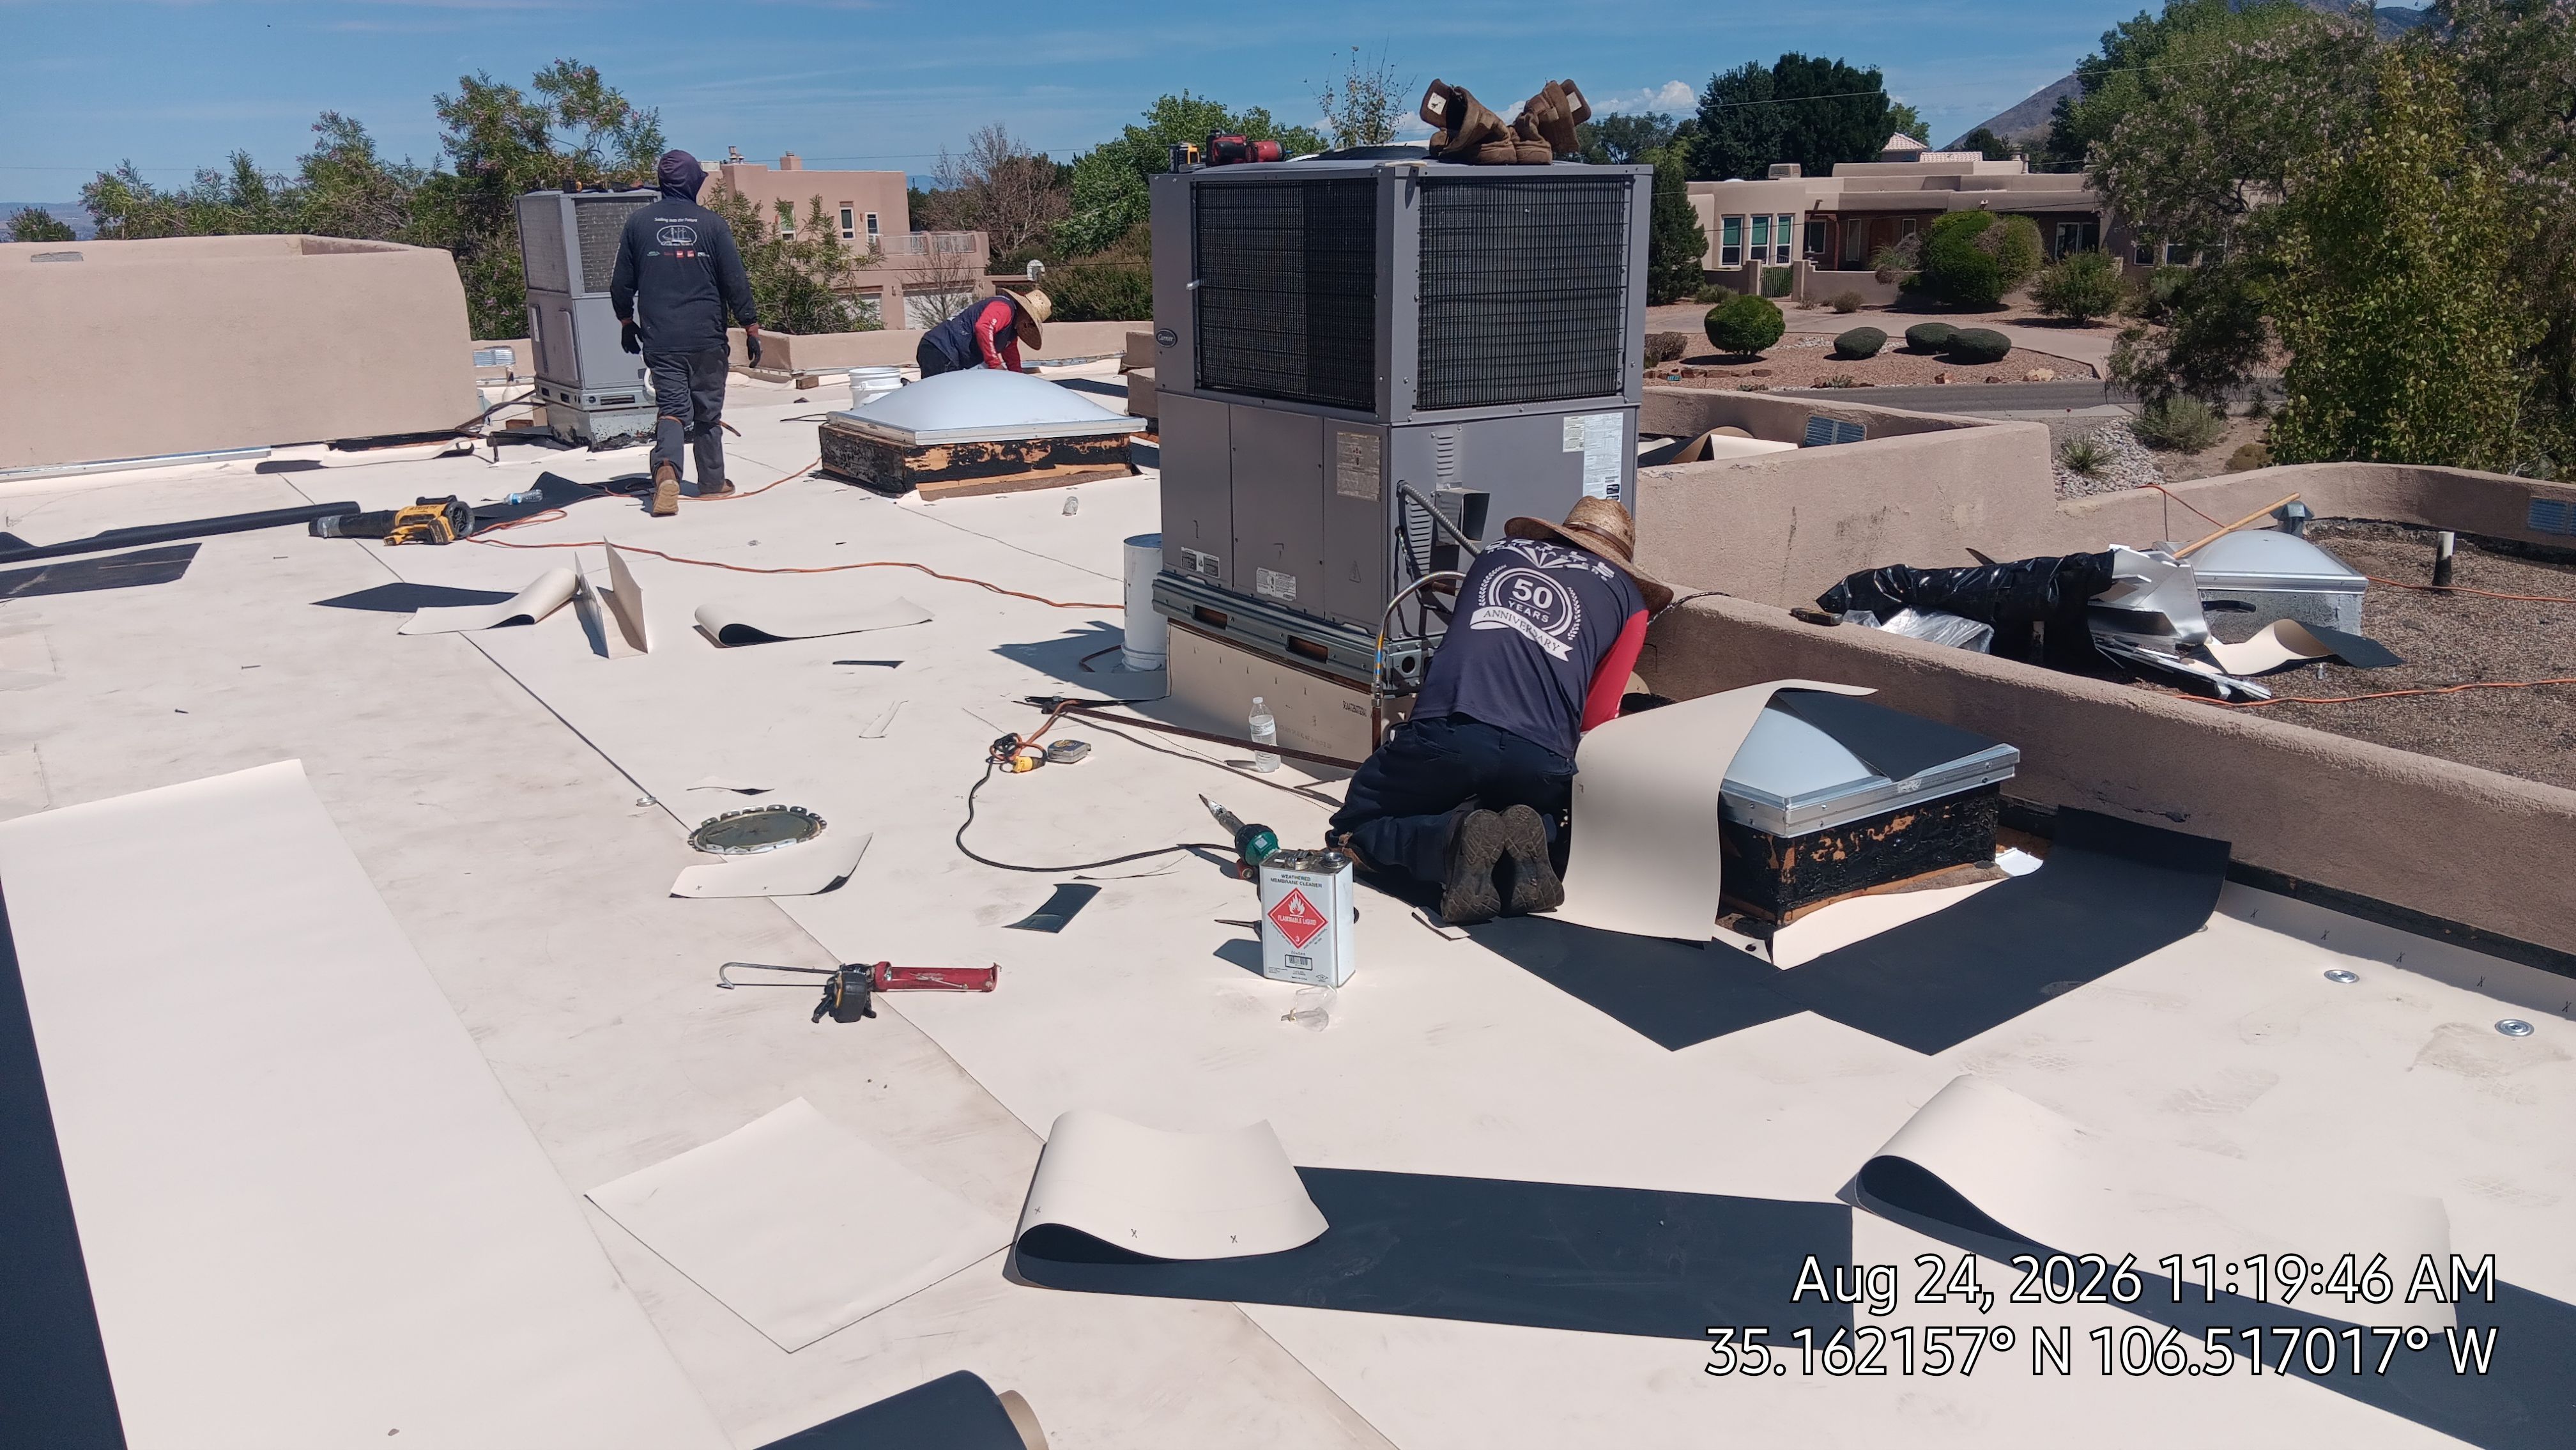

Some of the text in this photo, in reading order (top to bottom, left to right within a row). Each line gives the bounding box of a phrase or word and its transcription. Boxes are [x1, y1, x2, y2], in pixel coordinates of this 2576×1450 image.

[1512, 578, 1553, 610] 50
[1508, 599, 1549, 623] YEARS
[1483, 609, 1560, 652] ANNIVERSARY
[1281, 874, 1311, 882] WEATHERED
[1277, 914, 1303, 924] FLAMMABLE
